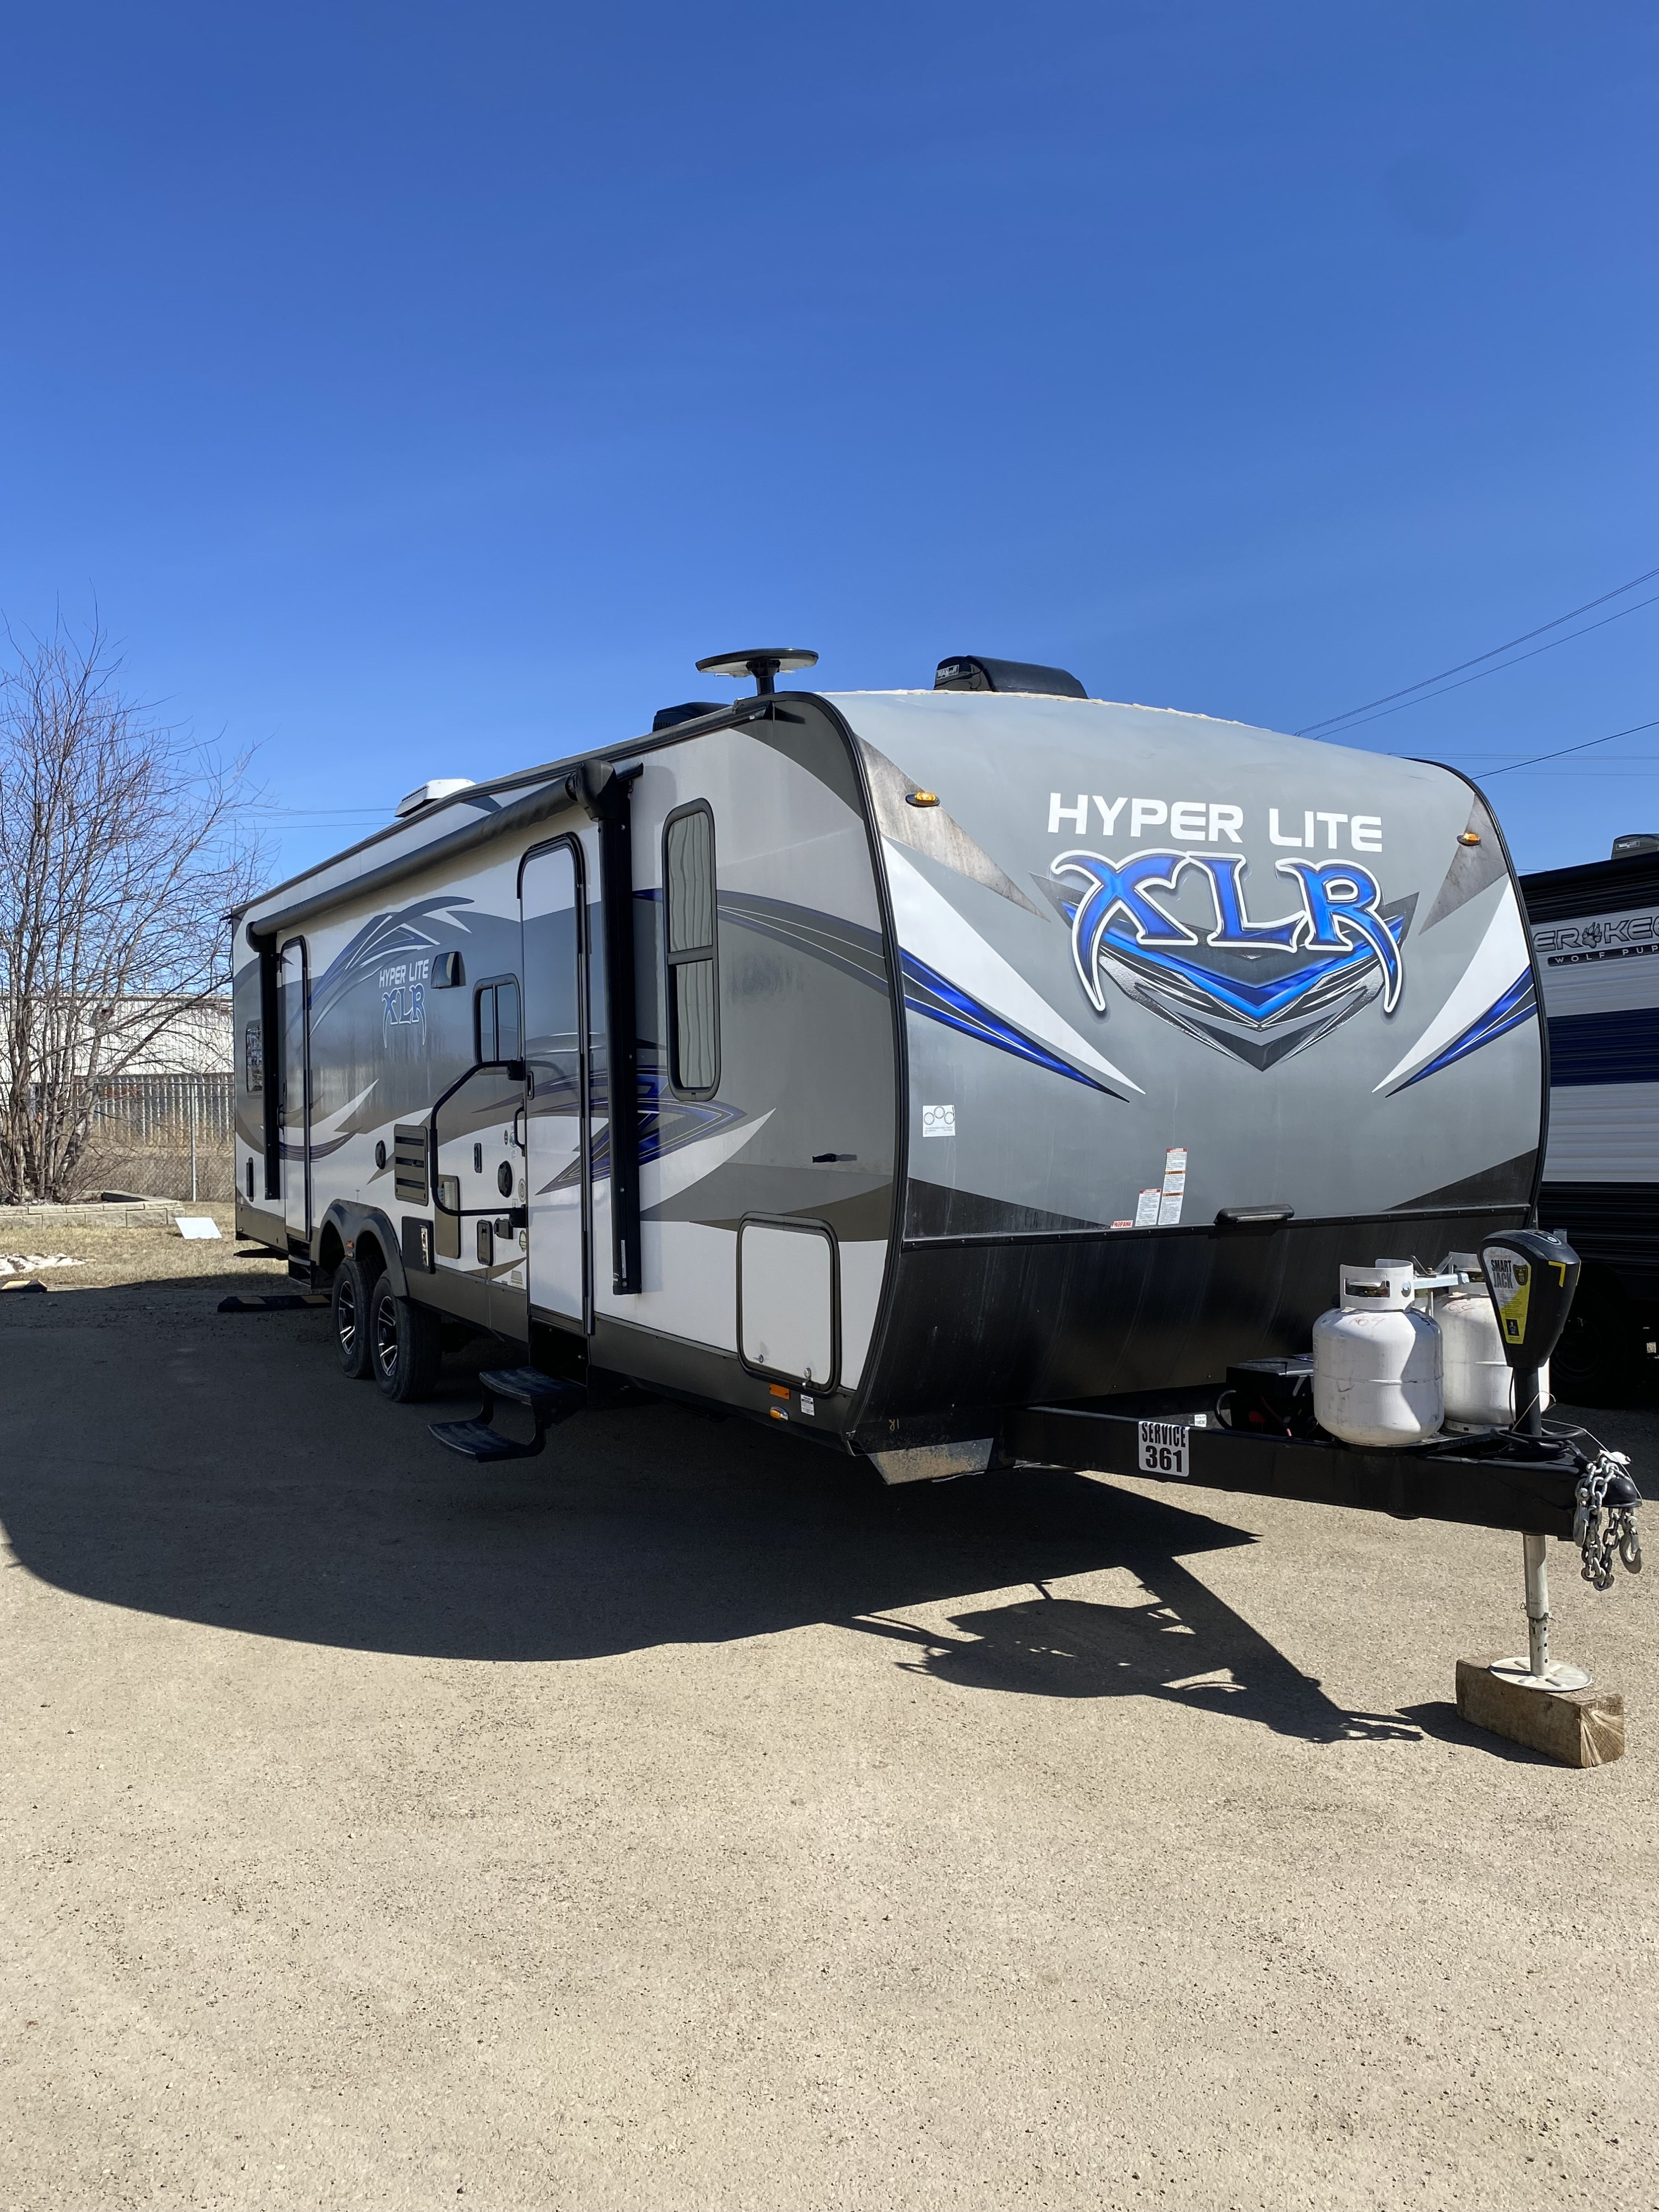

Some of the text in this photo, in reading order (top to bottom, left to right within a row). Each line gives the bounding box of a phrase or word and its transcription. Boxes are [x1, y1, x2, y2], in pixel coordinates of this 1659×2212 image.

[1048, 793, 1383, 852] HYPER LITE
[1050, 848, 1404, 1013] XLR
[1554, 945, 1658, 963] WOLF PUP
[379, 958, 429, 989] HYPER LITE
[382, 983, 427, 1049] XLR
[1490, 1259, 1512, 1272] SMART
[1493, 1272, 1514, 1289] JACK
[1141, 1422, 1186, 1448] SERVICE
[1145, 1445, 1182, 1473] 361
